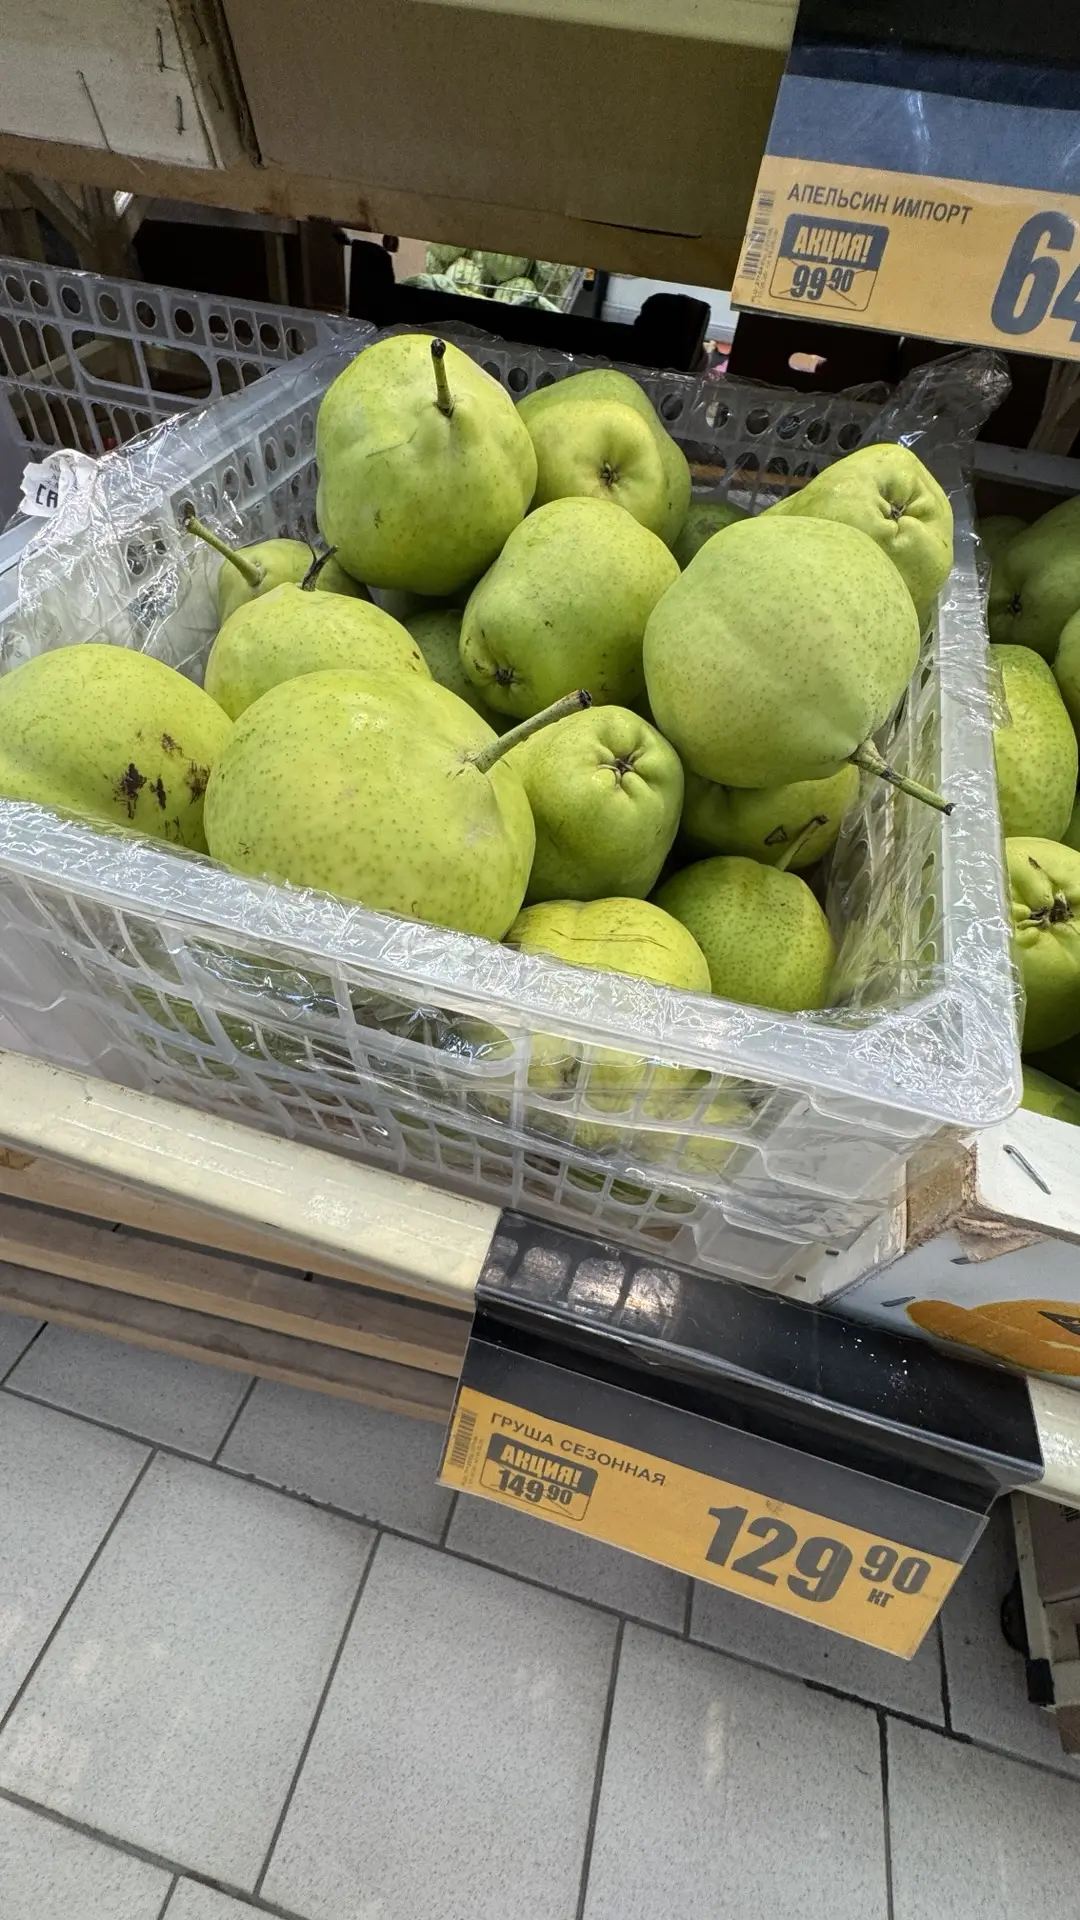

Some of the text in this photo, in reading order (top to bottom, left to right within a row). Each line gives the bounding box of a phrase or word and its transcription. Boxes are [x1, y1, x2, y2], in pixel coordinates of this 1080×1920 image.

[787, 183, 973, 225] АПЕЛЬСИН ИМПОРТ
[792, 226, 873, 264] АКЦИЯ!
[491, 1412, 668, 1487] ГРУША СЕЗОННАЯ
[500, 1444, 583, 1489] АКЦИЯ!
[498, 1469, 544, 1503] 149
[705, 1505, 931, 1603] 129 90
